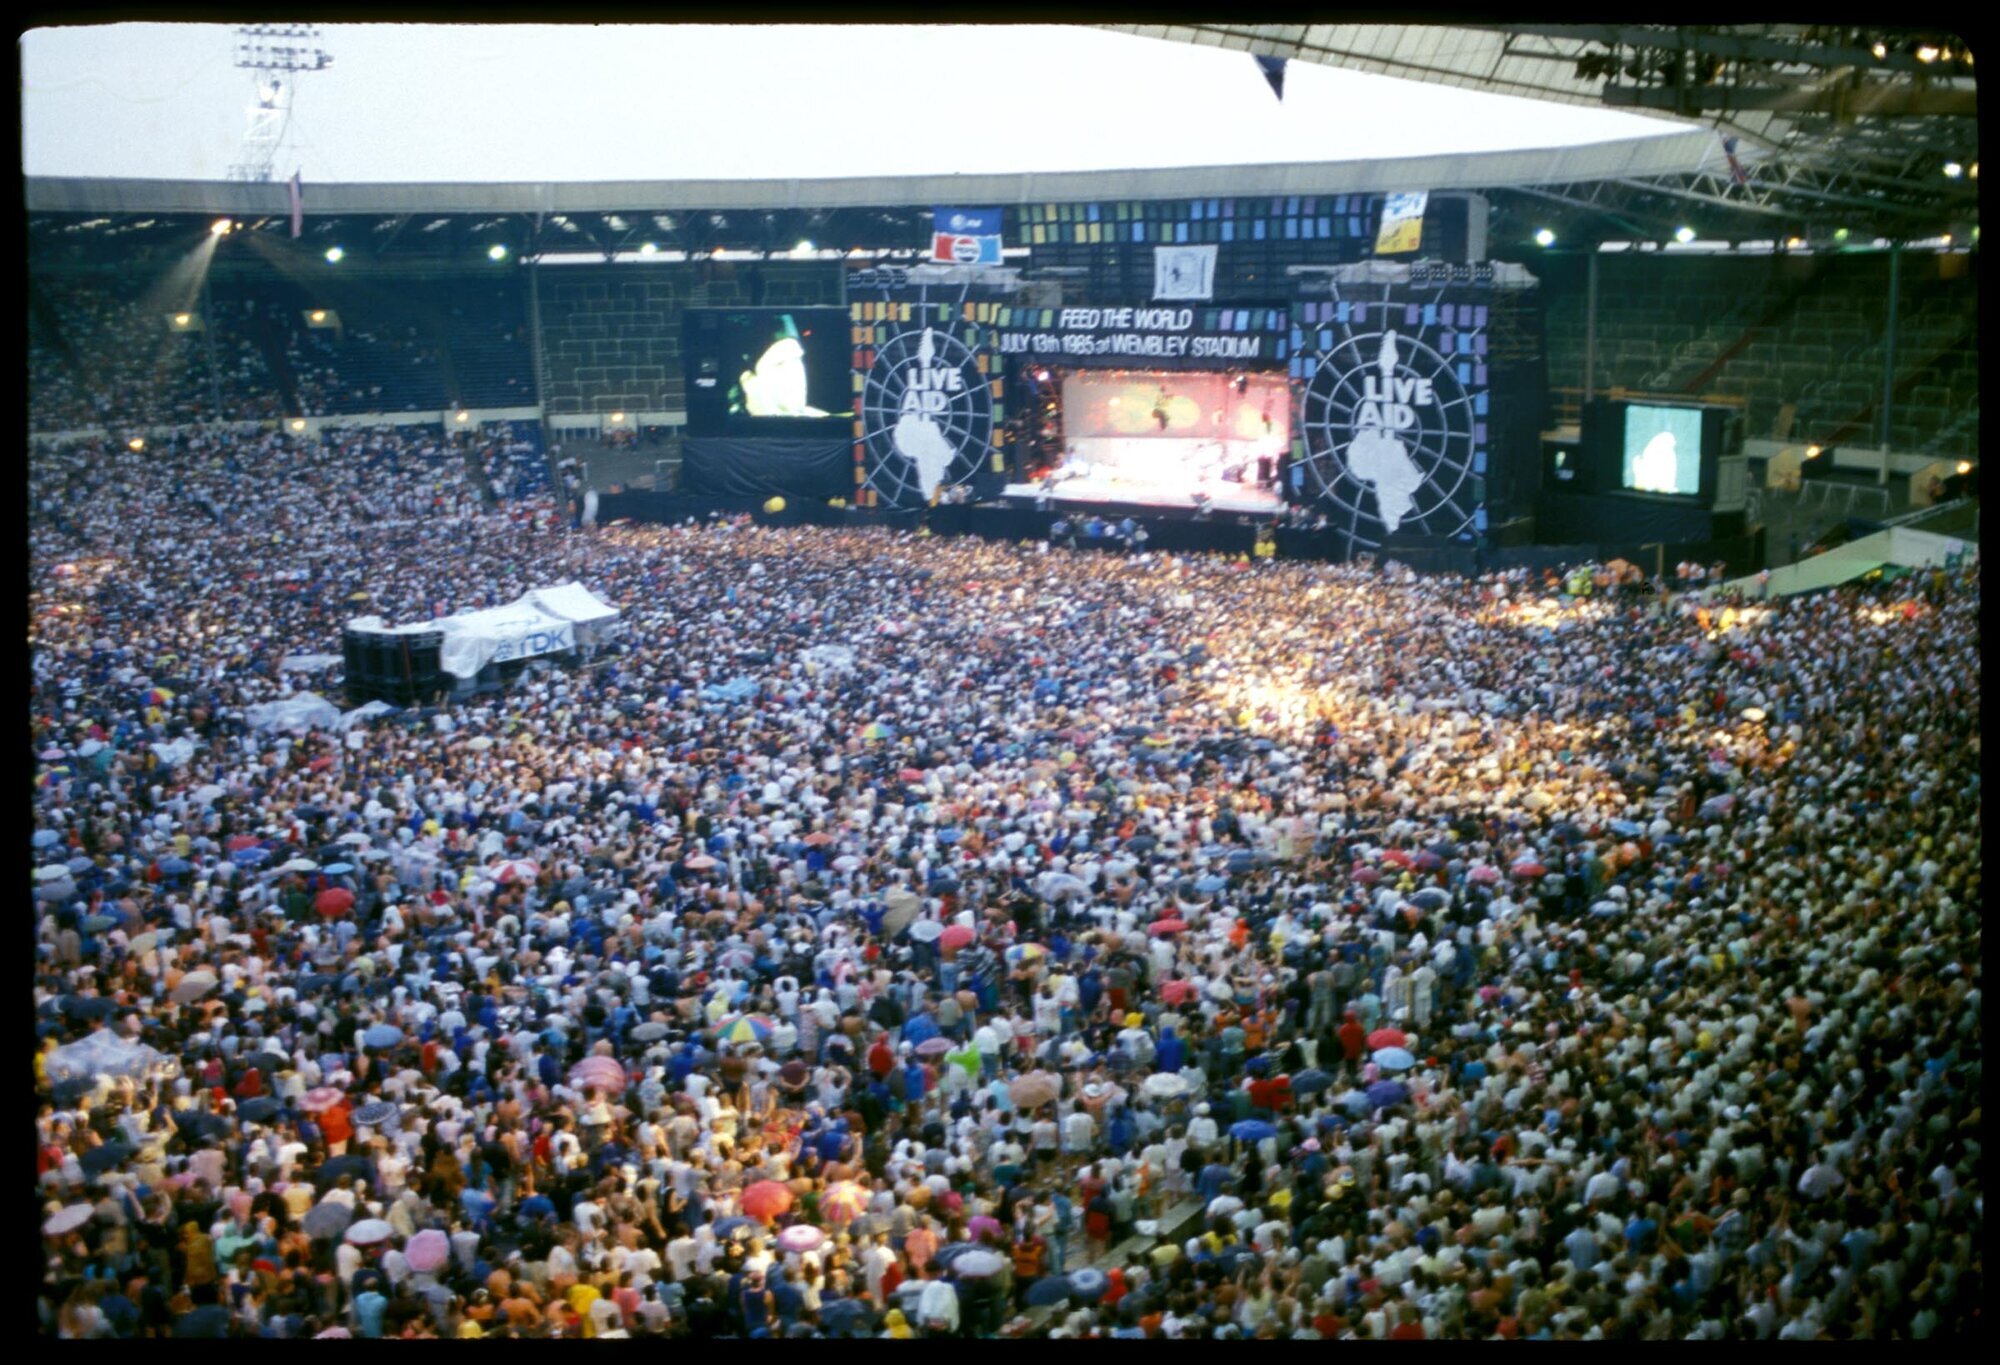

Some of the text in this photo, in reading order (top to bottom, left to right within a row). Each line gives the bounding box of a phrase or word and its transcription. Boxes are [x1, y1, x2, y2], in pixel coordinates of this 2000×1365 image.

[1059, 307, 1193, 331] FEED THE WORLD
[1000, 333, 1031, 353] JULY
[1032, 333, 1060, 353] 13th
[1061, 333, 1095, 355] 1985
[1110, 333, 1189, 357] WEMBLEY
[1190, 336, 1260, 358] STADIUM
[907, 367, 962, 391] LIVE
[1363, 375, 1433, 406] LIVE
[902, 390, 947, 412] AID
[1357, 401, 1415, 429] AID
